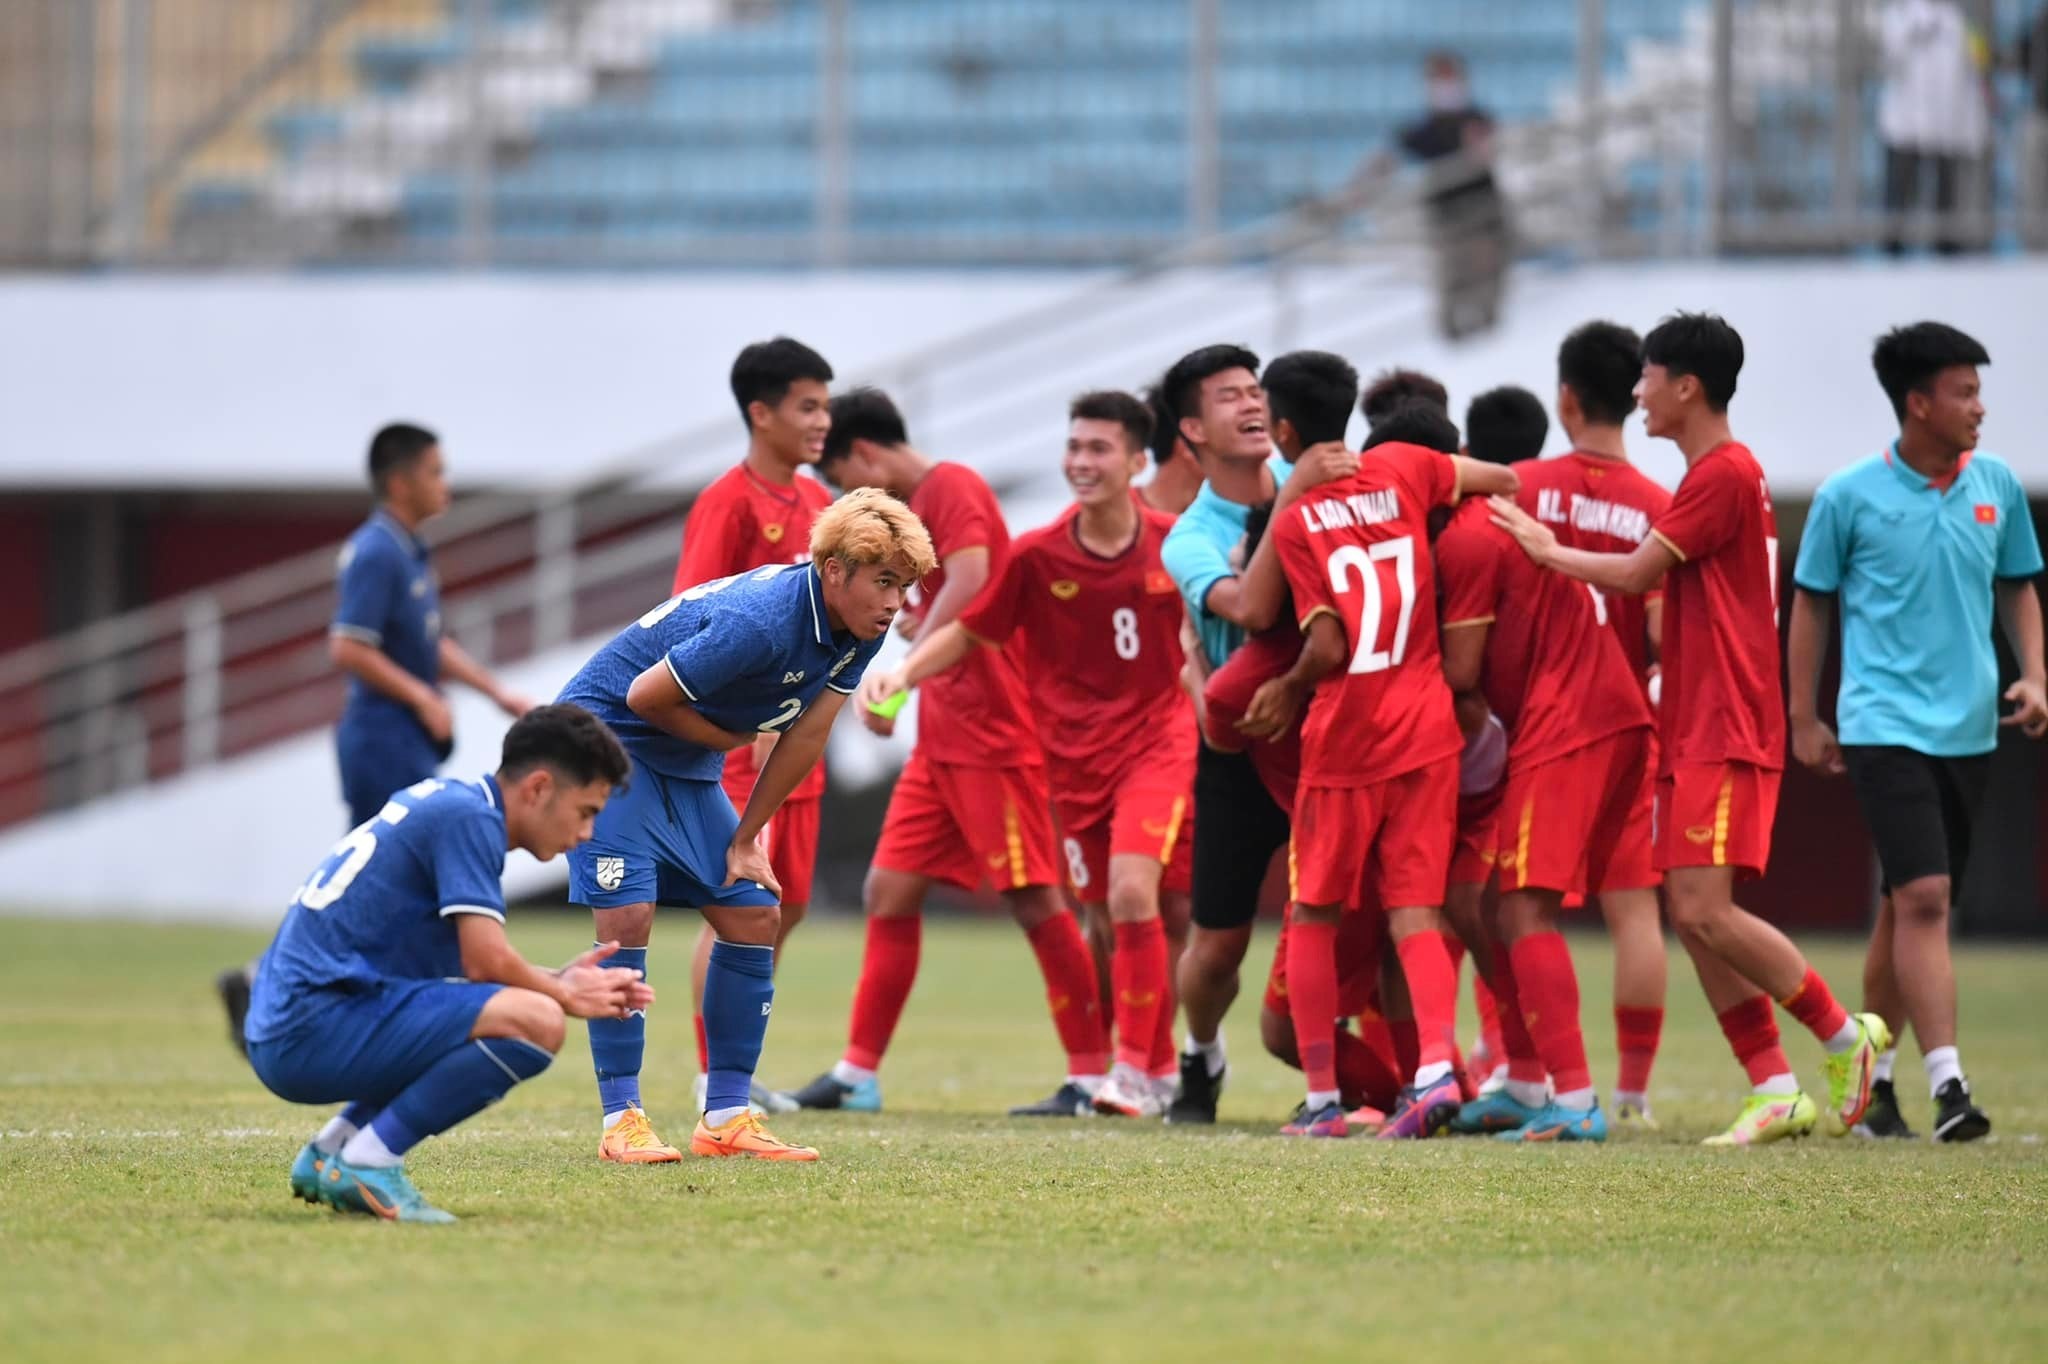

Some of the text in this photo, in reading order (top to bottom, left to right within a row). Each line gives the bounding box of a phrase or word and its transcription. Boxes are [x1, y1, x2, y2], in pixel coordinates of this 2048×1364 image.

[1327, 535, 1416, 675] 27
[1112, 607, 1140, 660] 8
[1063, 837, 1089, 888] 8
